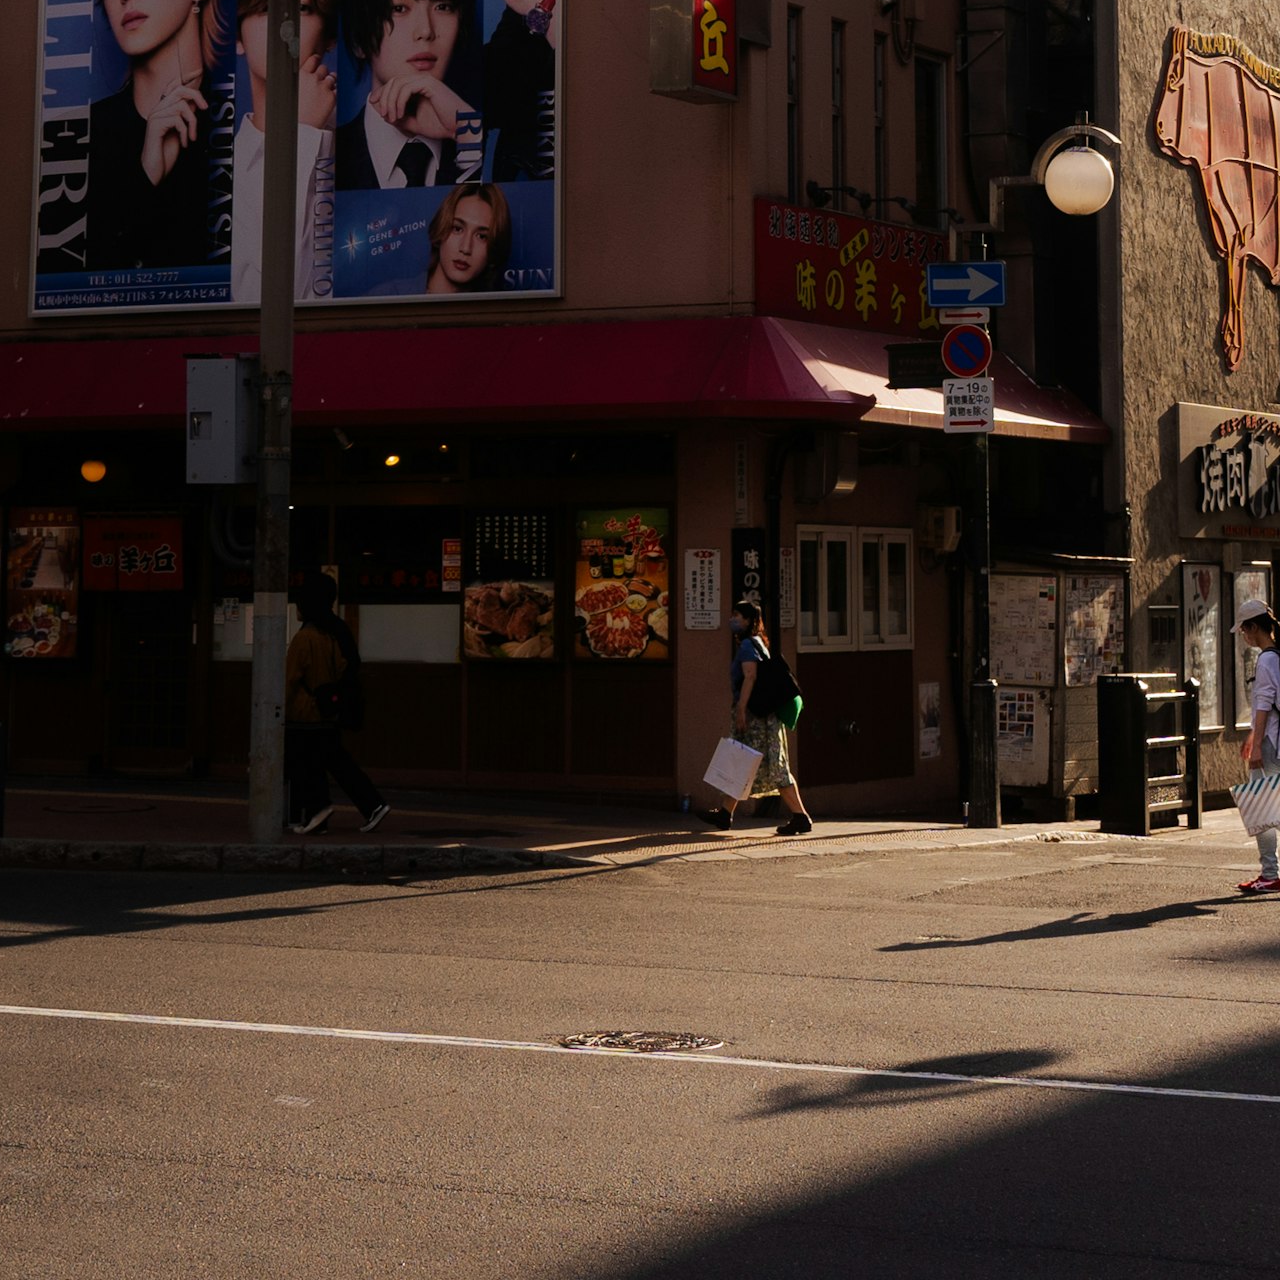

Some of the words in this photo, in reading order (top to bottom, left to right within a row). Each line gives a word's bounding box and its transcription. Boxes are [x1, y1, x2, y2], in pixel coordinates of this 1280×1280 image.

[455, 109, 483, 185] RIN
[206, 73, 235, 260] TSUKASA
[311, 154, 335, 297] MICHITO
[365, 218, 388, 231] NEW
[368, 219, 427, 243] GENERATION
[767, 204, 839, 251] 北海道名物
[871, 225, 945, 267] ジンギスカ
[370, 239, 402, 257] GROUP
[115, 272, 180, 285] 011-522-7777
[504, 266, 553, 290] SUN
[945, 395, 990, 406] 貨物集配中の
[948, 405, 989, 417] 貨物を除く
